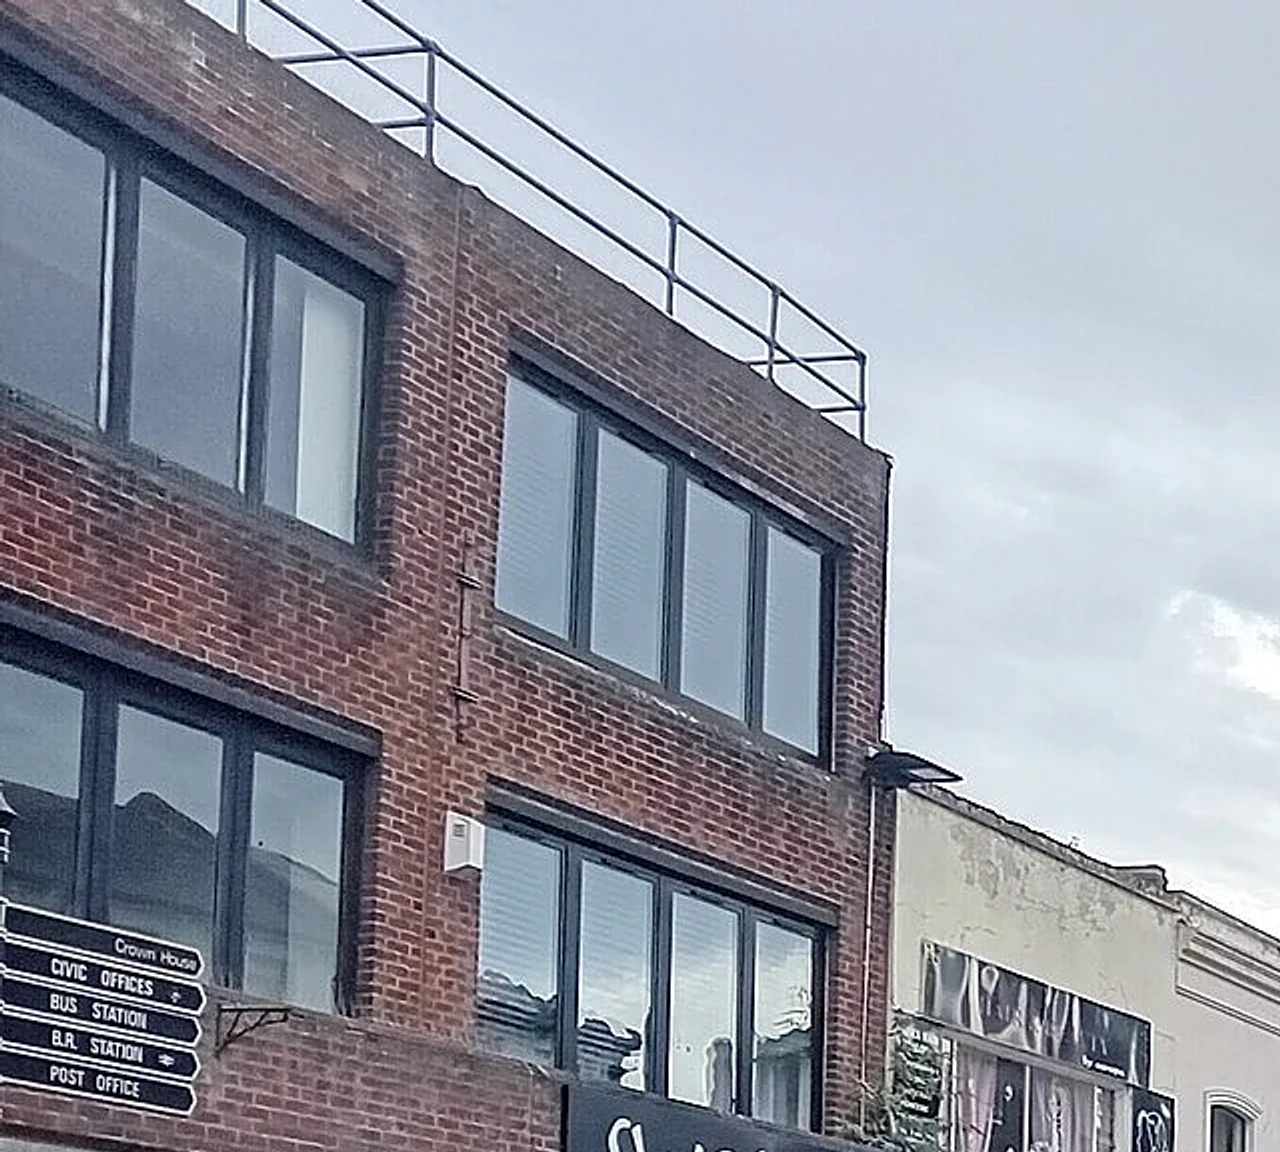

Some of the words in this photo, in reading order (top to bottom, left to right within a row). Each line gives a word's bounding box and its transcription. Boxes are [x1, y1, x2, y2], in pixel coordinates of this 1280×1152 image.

[114, 938, 157, 961] Crown
[160, 951, 197, 971] House
[51, 958, 88, 981] CIVIC
[100, 970, 154, 996] OFFICES
[49, 993, 78, 1014] BUS
[92, 1003, 148, 1029] STATION
[51, 1030, 78, 1050] B.R.
[90, 1038, 143, 1063] STATION
[49, 1065, 85, 1087] POST
[95, 1077, 140, 1098] OFFICE
